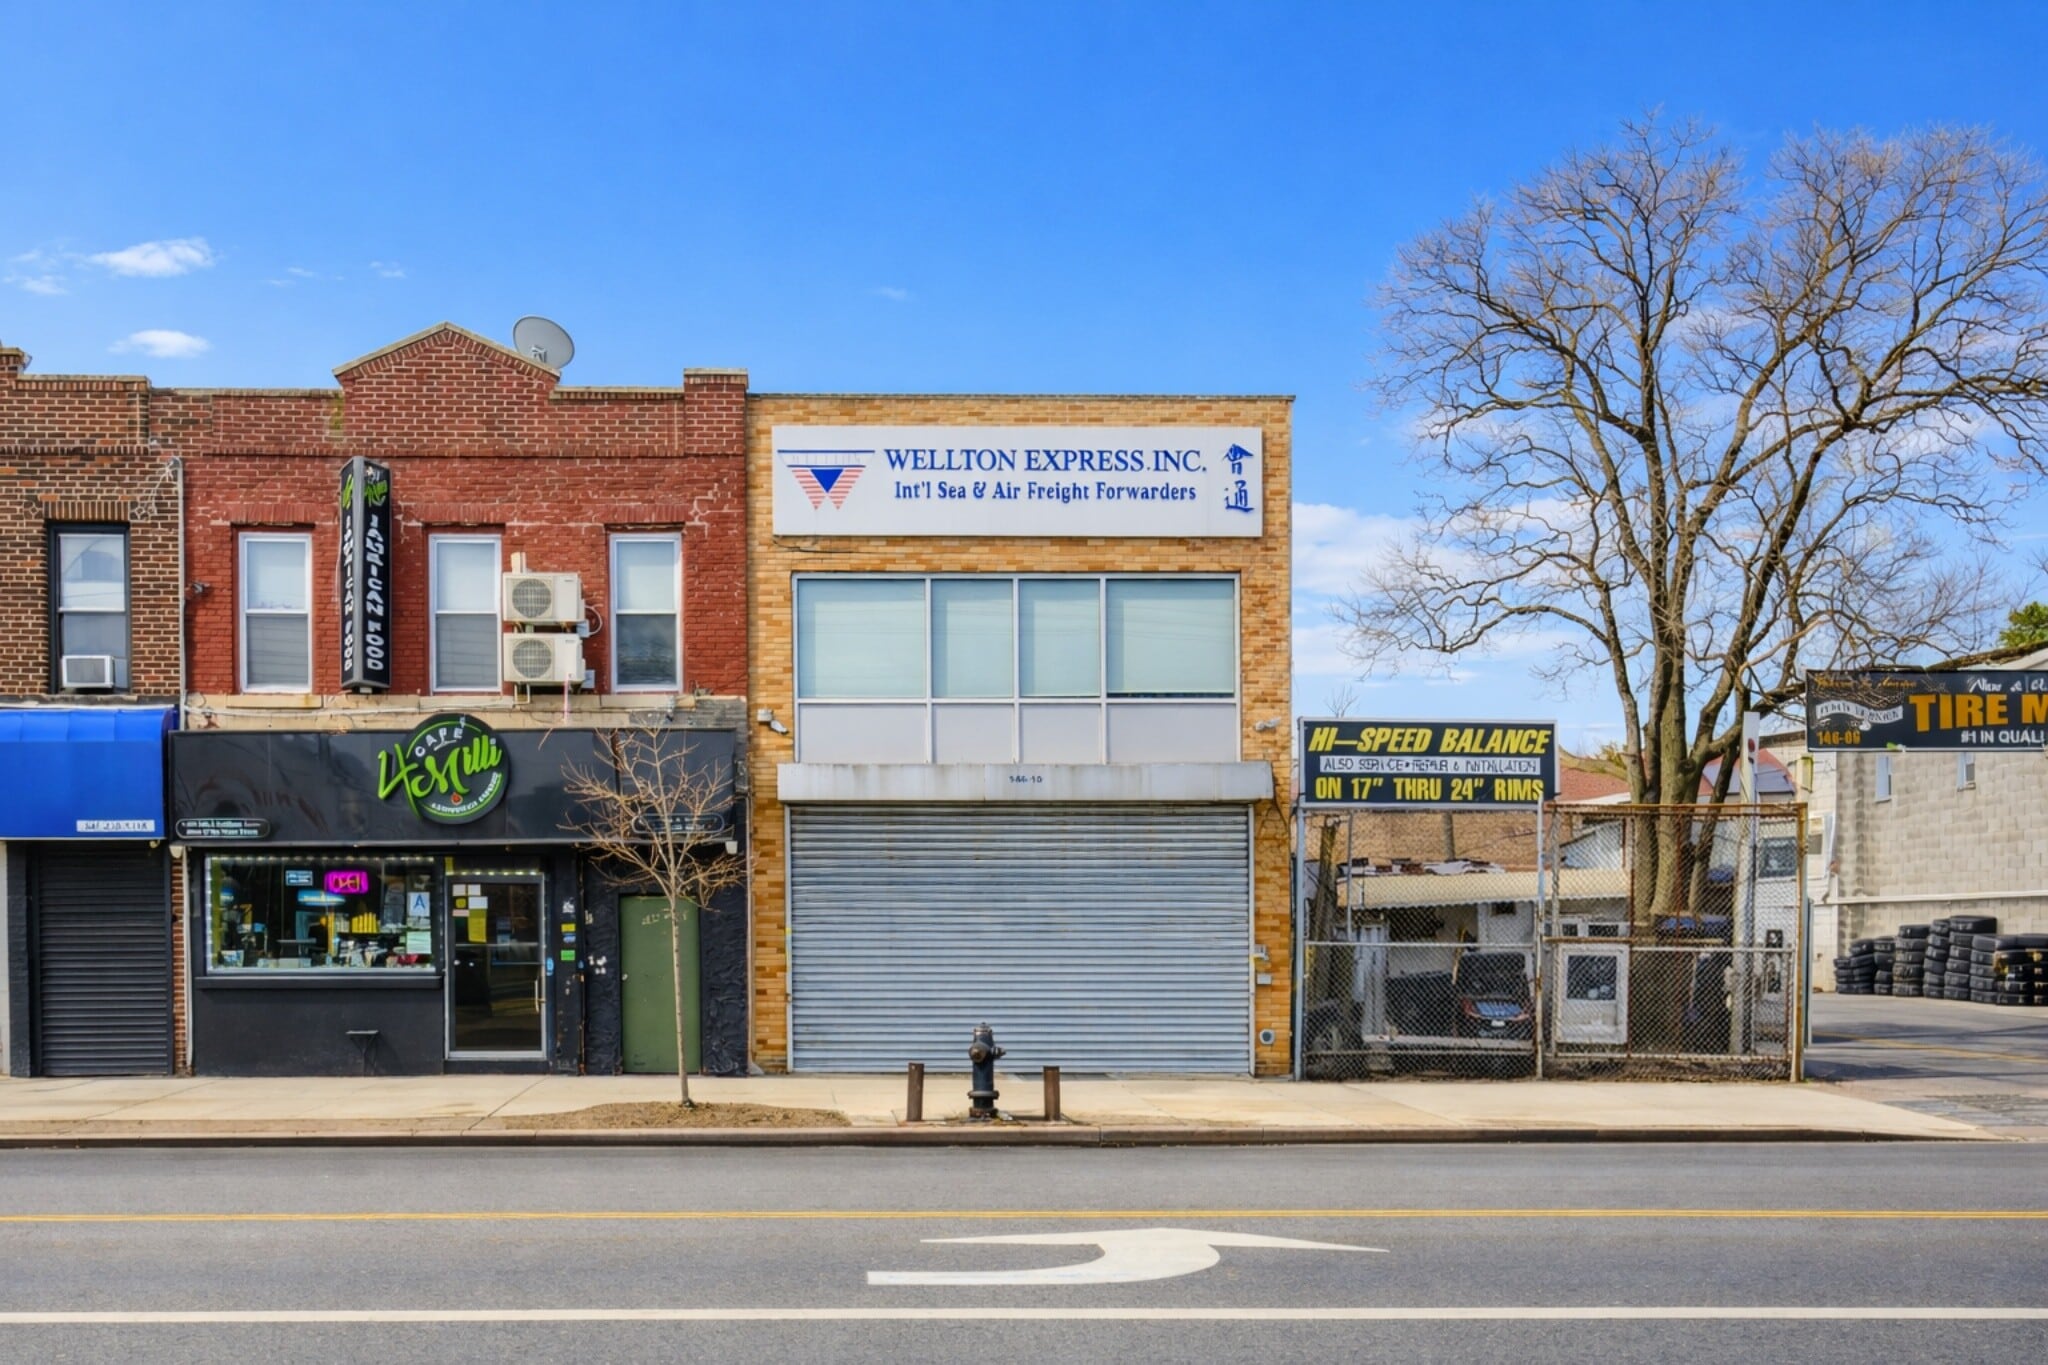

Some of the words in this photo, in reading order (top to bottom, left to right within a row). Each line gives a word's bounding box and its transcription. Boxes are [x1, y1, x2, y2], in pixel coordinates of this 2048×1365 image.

[884, 449, 1016, 472] WELLTON
[894, 481, 932, 500] Int'l
[938, 481, 966, 500] Sea
[973, 481, 987, 500] &
[993, 481, 1020, 500] Air
[1027, 480, 1089, 503] Freight
[1097, 480, 1197, 501] Forwarders
[1909, 694, 2008, 733] TIRE
[1440, 728, 1552, 754] BALANCE
[1980, 730, 1995, 744] IN
[1323, 758, 1354, 771] ALSO
[1315, 777, 1342, 800] ON
[1351, 777, 1384, 800] 17"
[1393, 778, 1442, 800] THRU
[1450, 778, 1484, 800] 24"
[1494, 779, 1544, 801] RIMS
[413, 893, 426, 910] A
